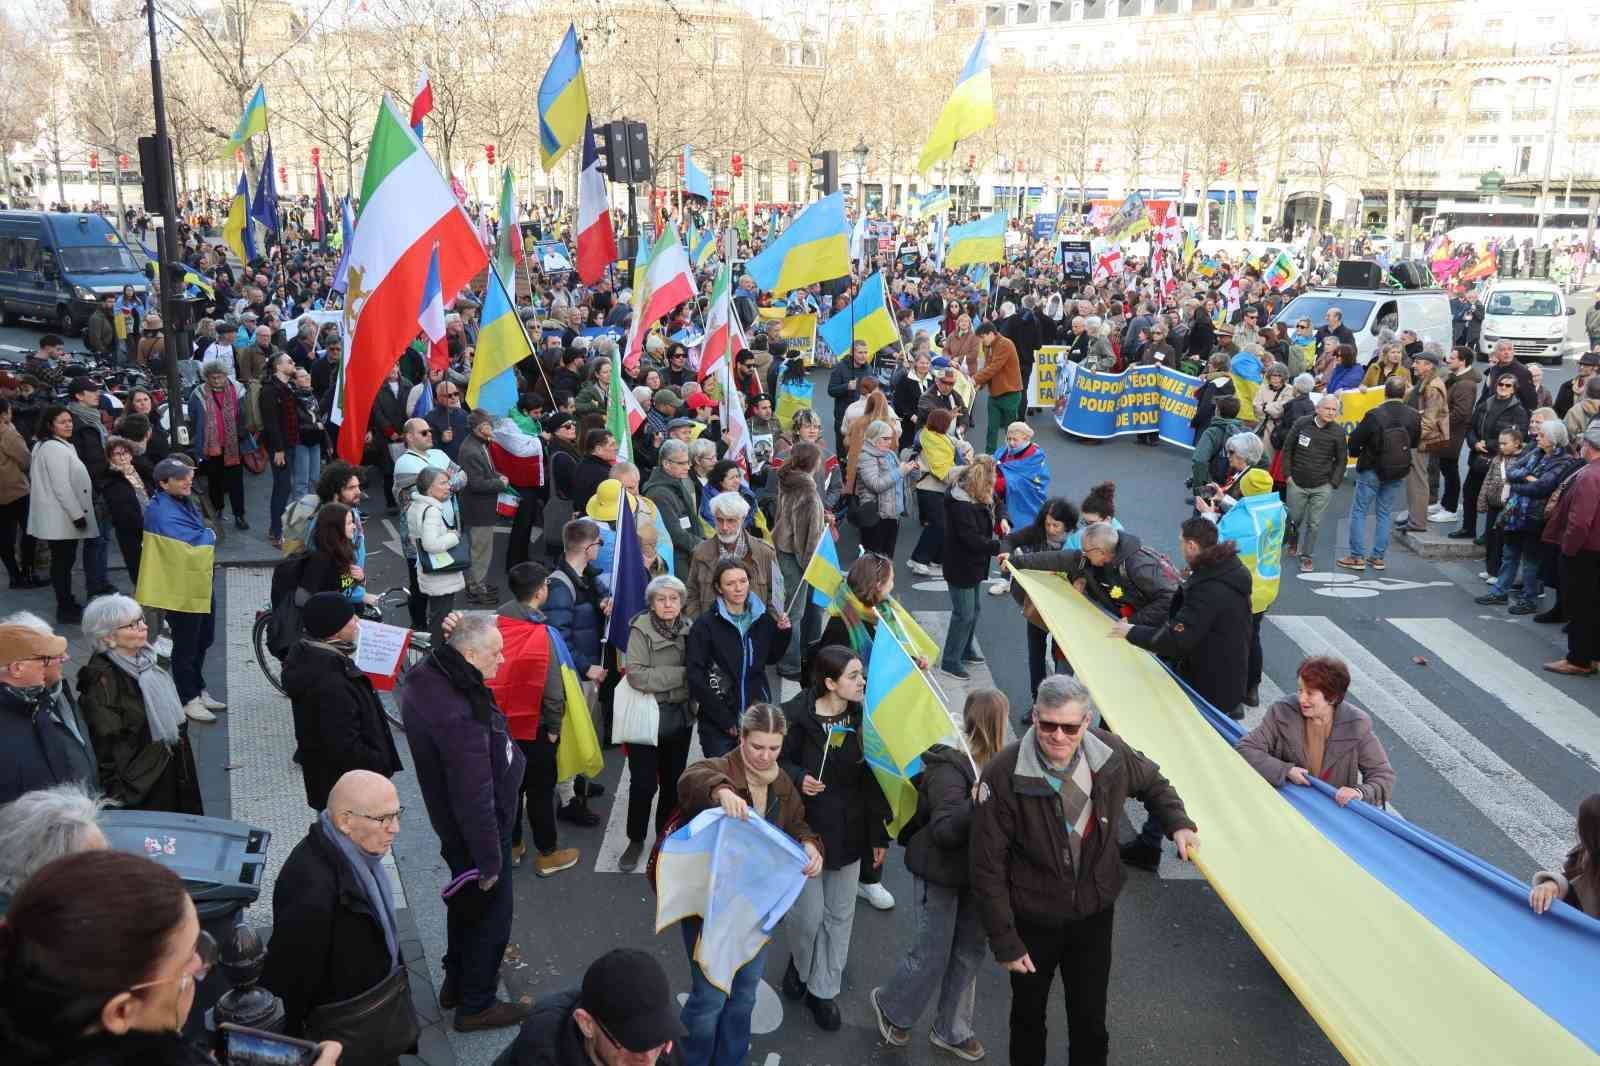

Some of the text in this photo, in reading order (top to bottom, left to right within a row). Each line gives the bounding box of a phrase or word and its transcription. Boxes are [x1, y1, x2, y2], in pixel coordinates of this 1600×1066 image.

[1080, 397, 1115, 413] POUR
[1116, 410, 1159, 428] DE POU
